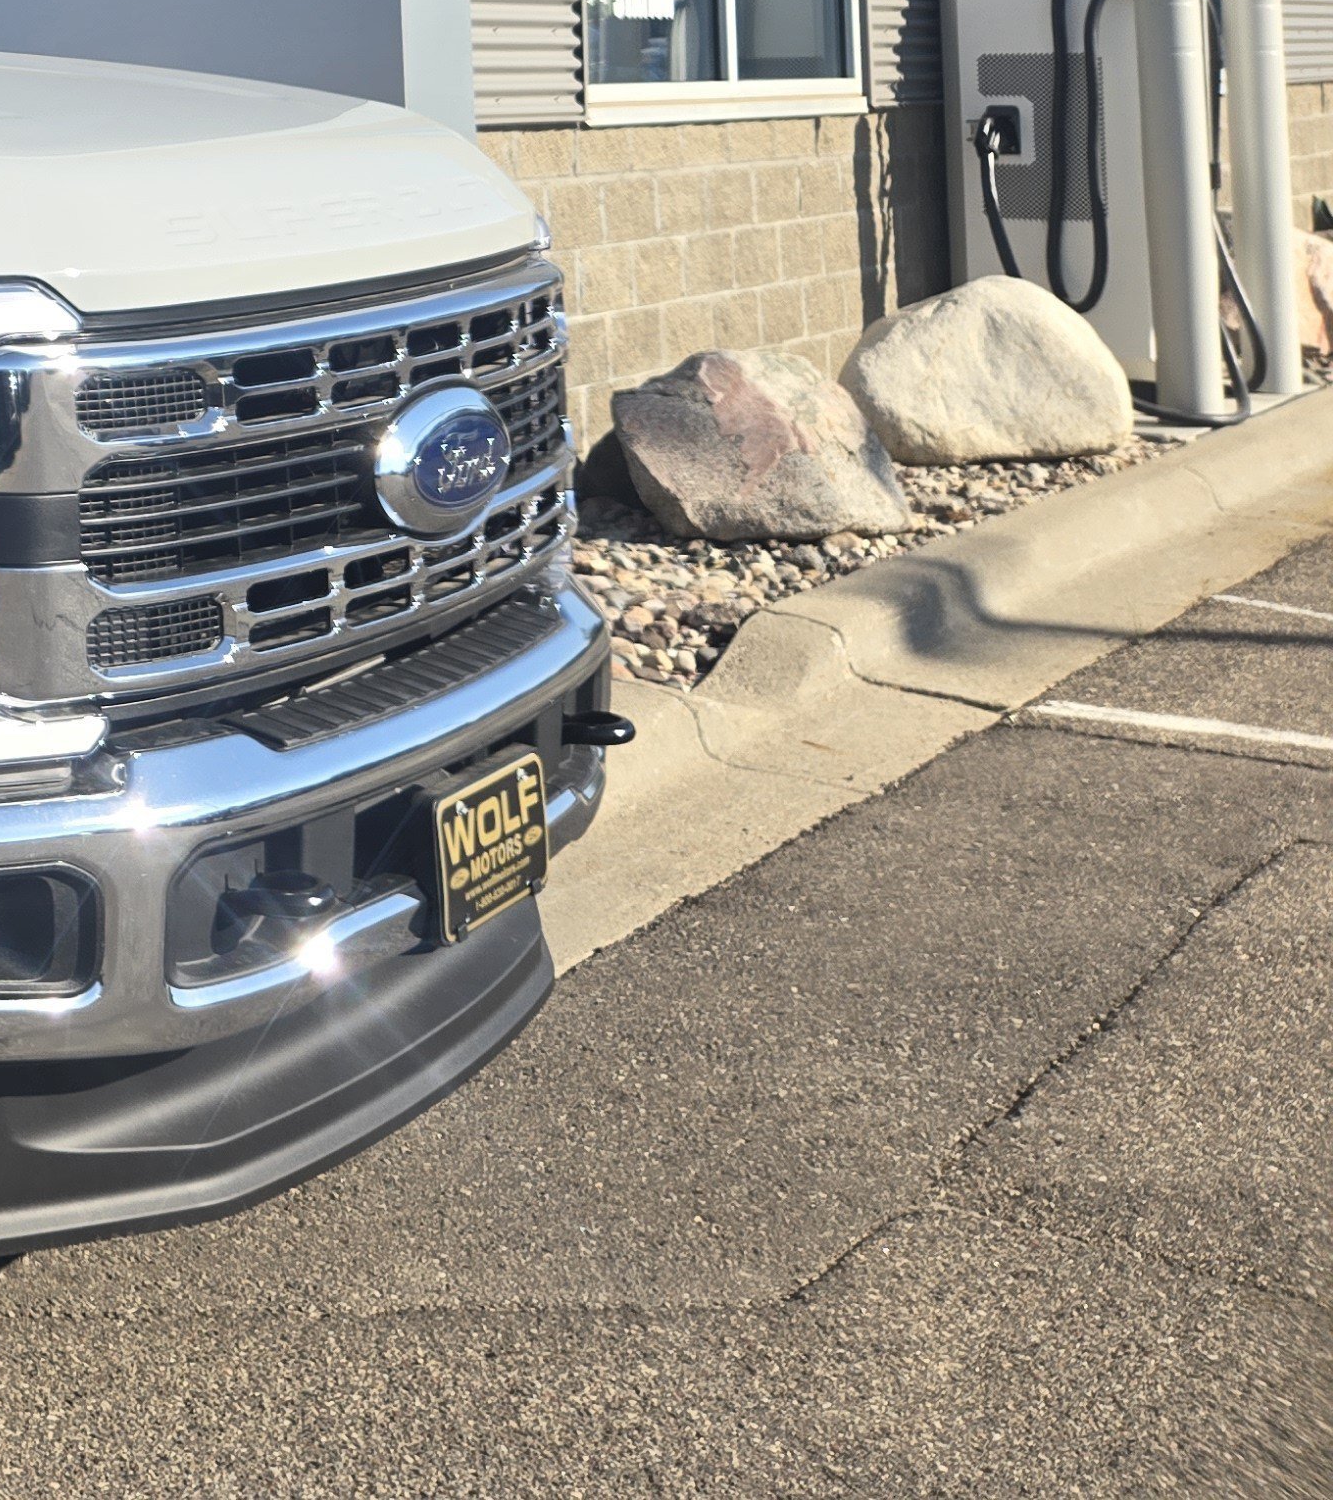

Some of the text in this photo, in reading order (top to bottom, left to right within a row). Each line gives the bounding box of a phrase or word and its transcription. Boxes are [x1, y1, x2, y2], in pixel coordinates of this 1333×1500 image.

[437, 428, 497, 494] Ford
[443, 774, 539, 866] WOLF
[470, 832, 524, 883] MOTORS
